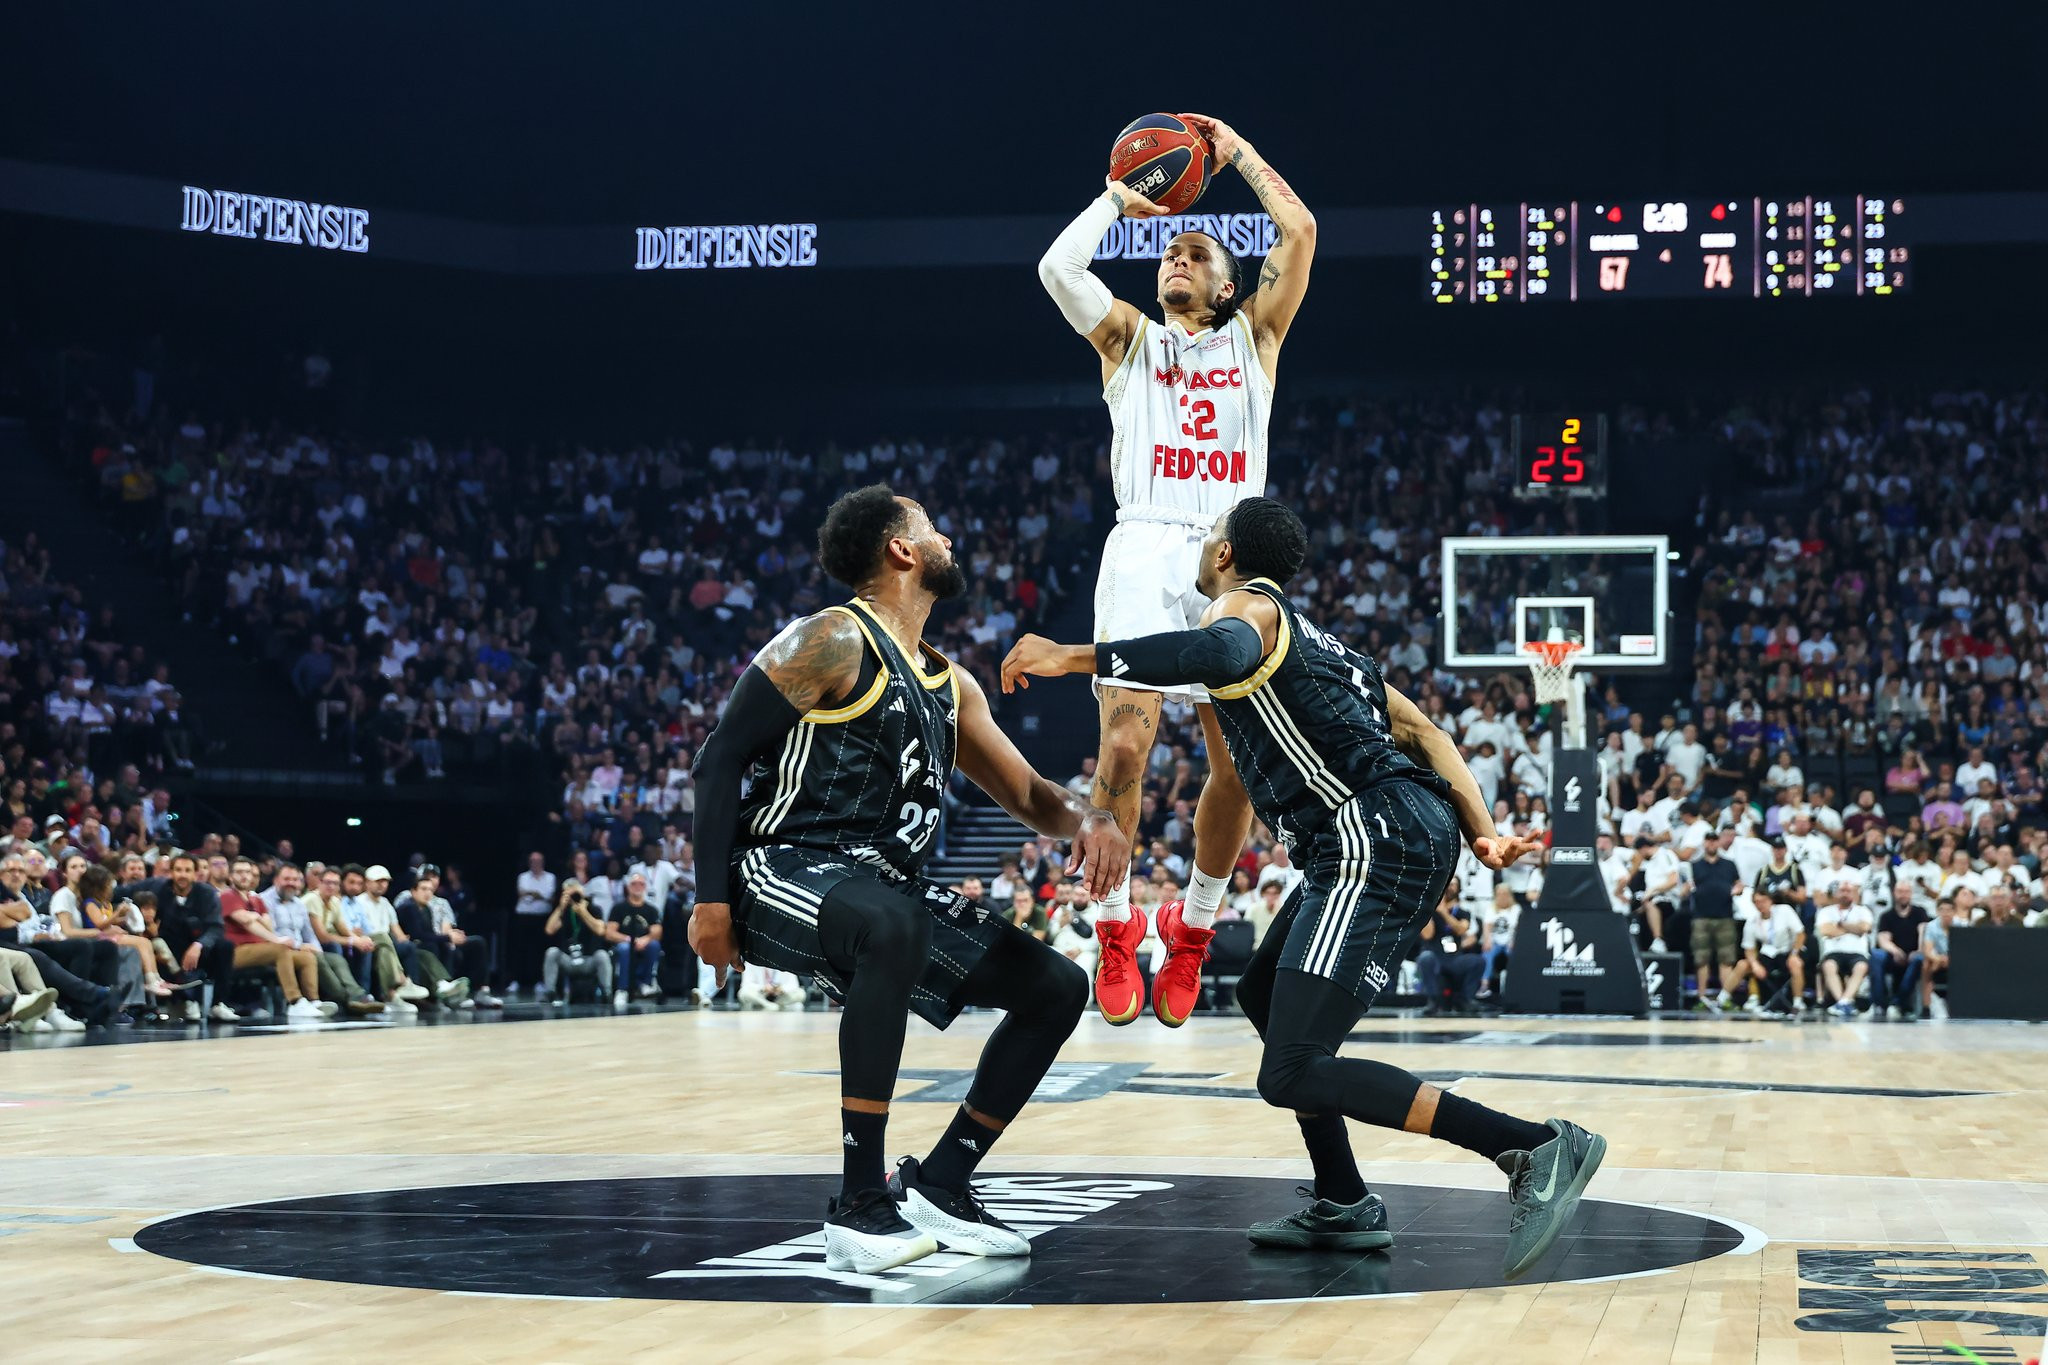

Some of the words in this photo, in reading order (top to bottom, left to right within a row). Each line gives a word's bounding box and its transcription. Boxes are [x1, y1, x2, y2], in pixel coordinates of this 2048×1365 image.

[180, 185, 370, 253] DEFENSE
[634, 223, 818, 270] DEFENSE
[1703, 254, 1734, 289] 74
[1562, 418, 1581, 444] 2
[1531, 446, 1585, 482] 25
[1142, 716, 1151, 730] MY
[896, 801, 940, 853] 23
[1373, 812, 1389, 839] 1
